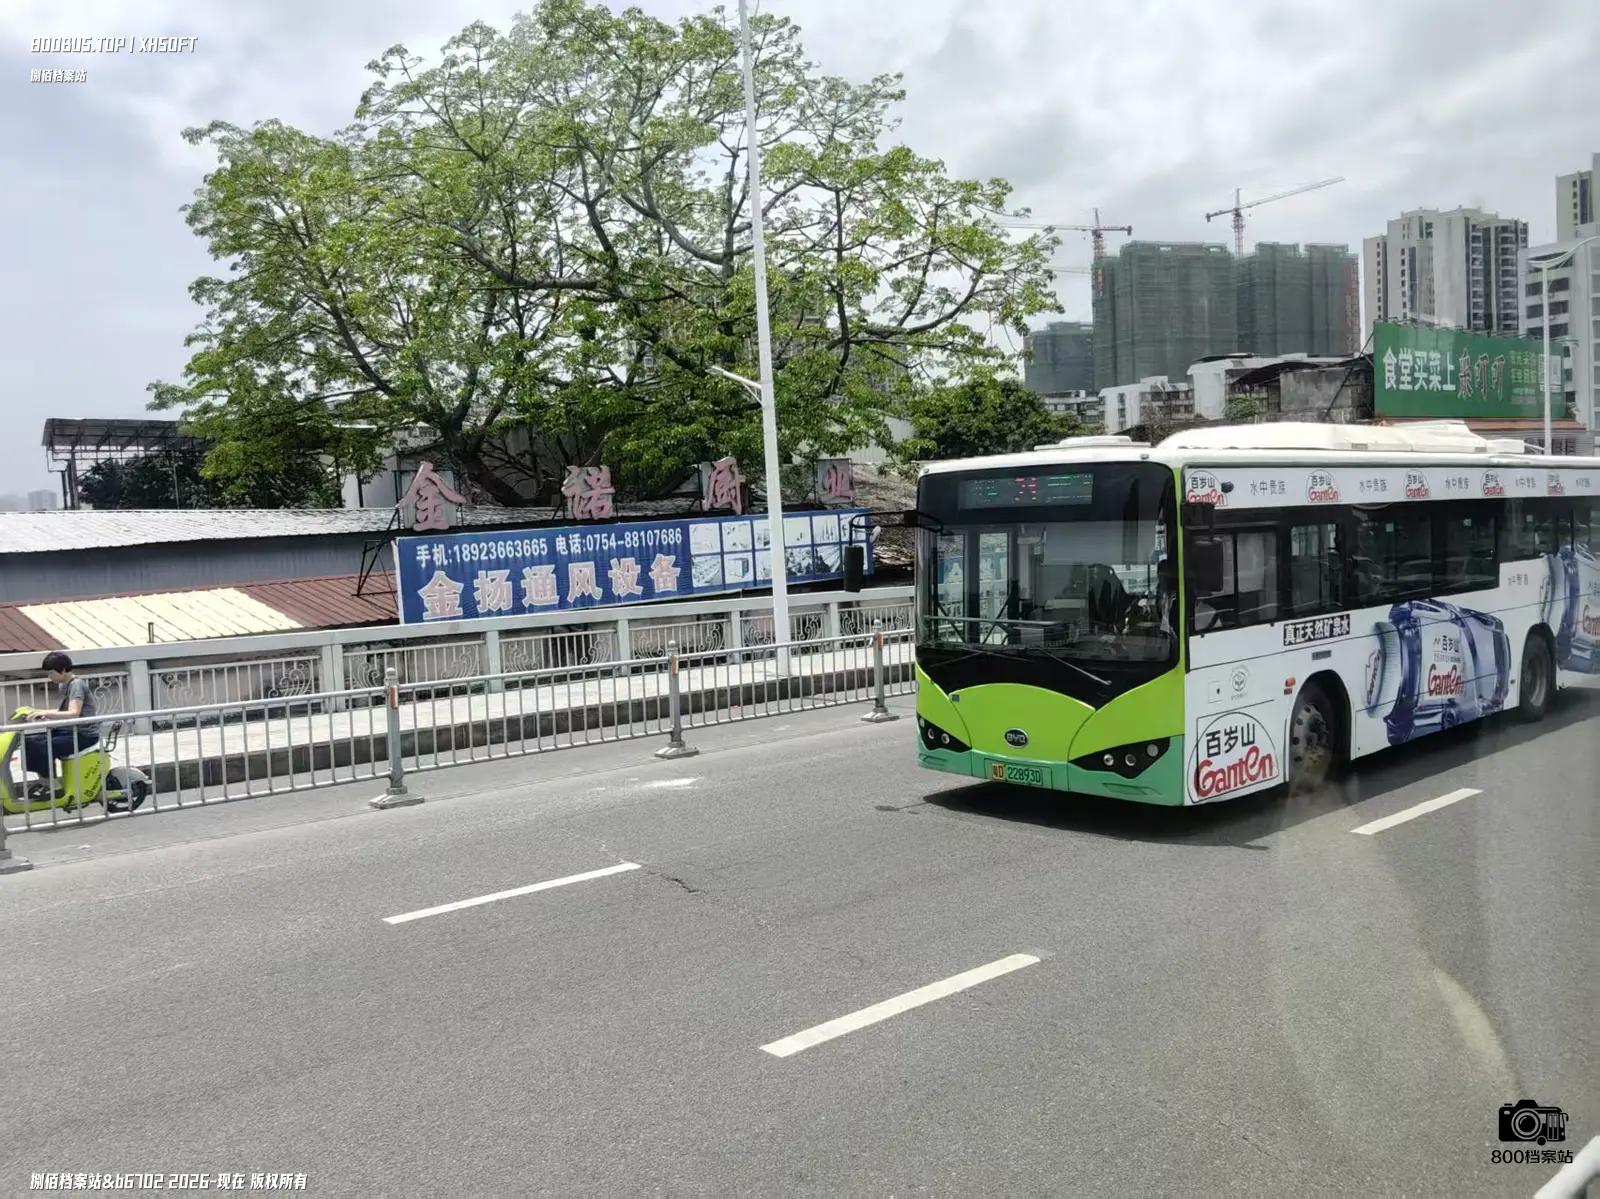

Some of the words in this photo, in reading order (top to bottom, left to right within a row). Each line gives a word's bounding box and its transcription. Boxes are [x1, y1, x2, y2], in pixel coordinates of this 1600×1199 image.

[1191, 476, 1216, 489] 百岁山
[1250, 480, 1287, 496] 水中贵族
[1311, 475, 1332, 487] 百岁山
[1359, 478, 1388, 494] 水中贵族
[555, 528, 683, 555] 电话:0754-88107686
[417, 553, 681, 621] 金扬通风设备
[1285, 614, 1350, 645] 真正天然矿泉水
[1006, 733, 1026, 743] BYD
[1206, 723, 1256, 758] 百岁山
